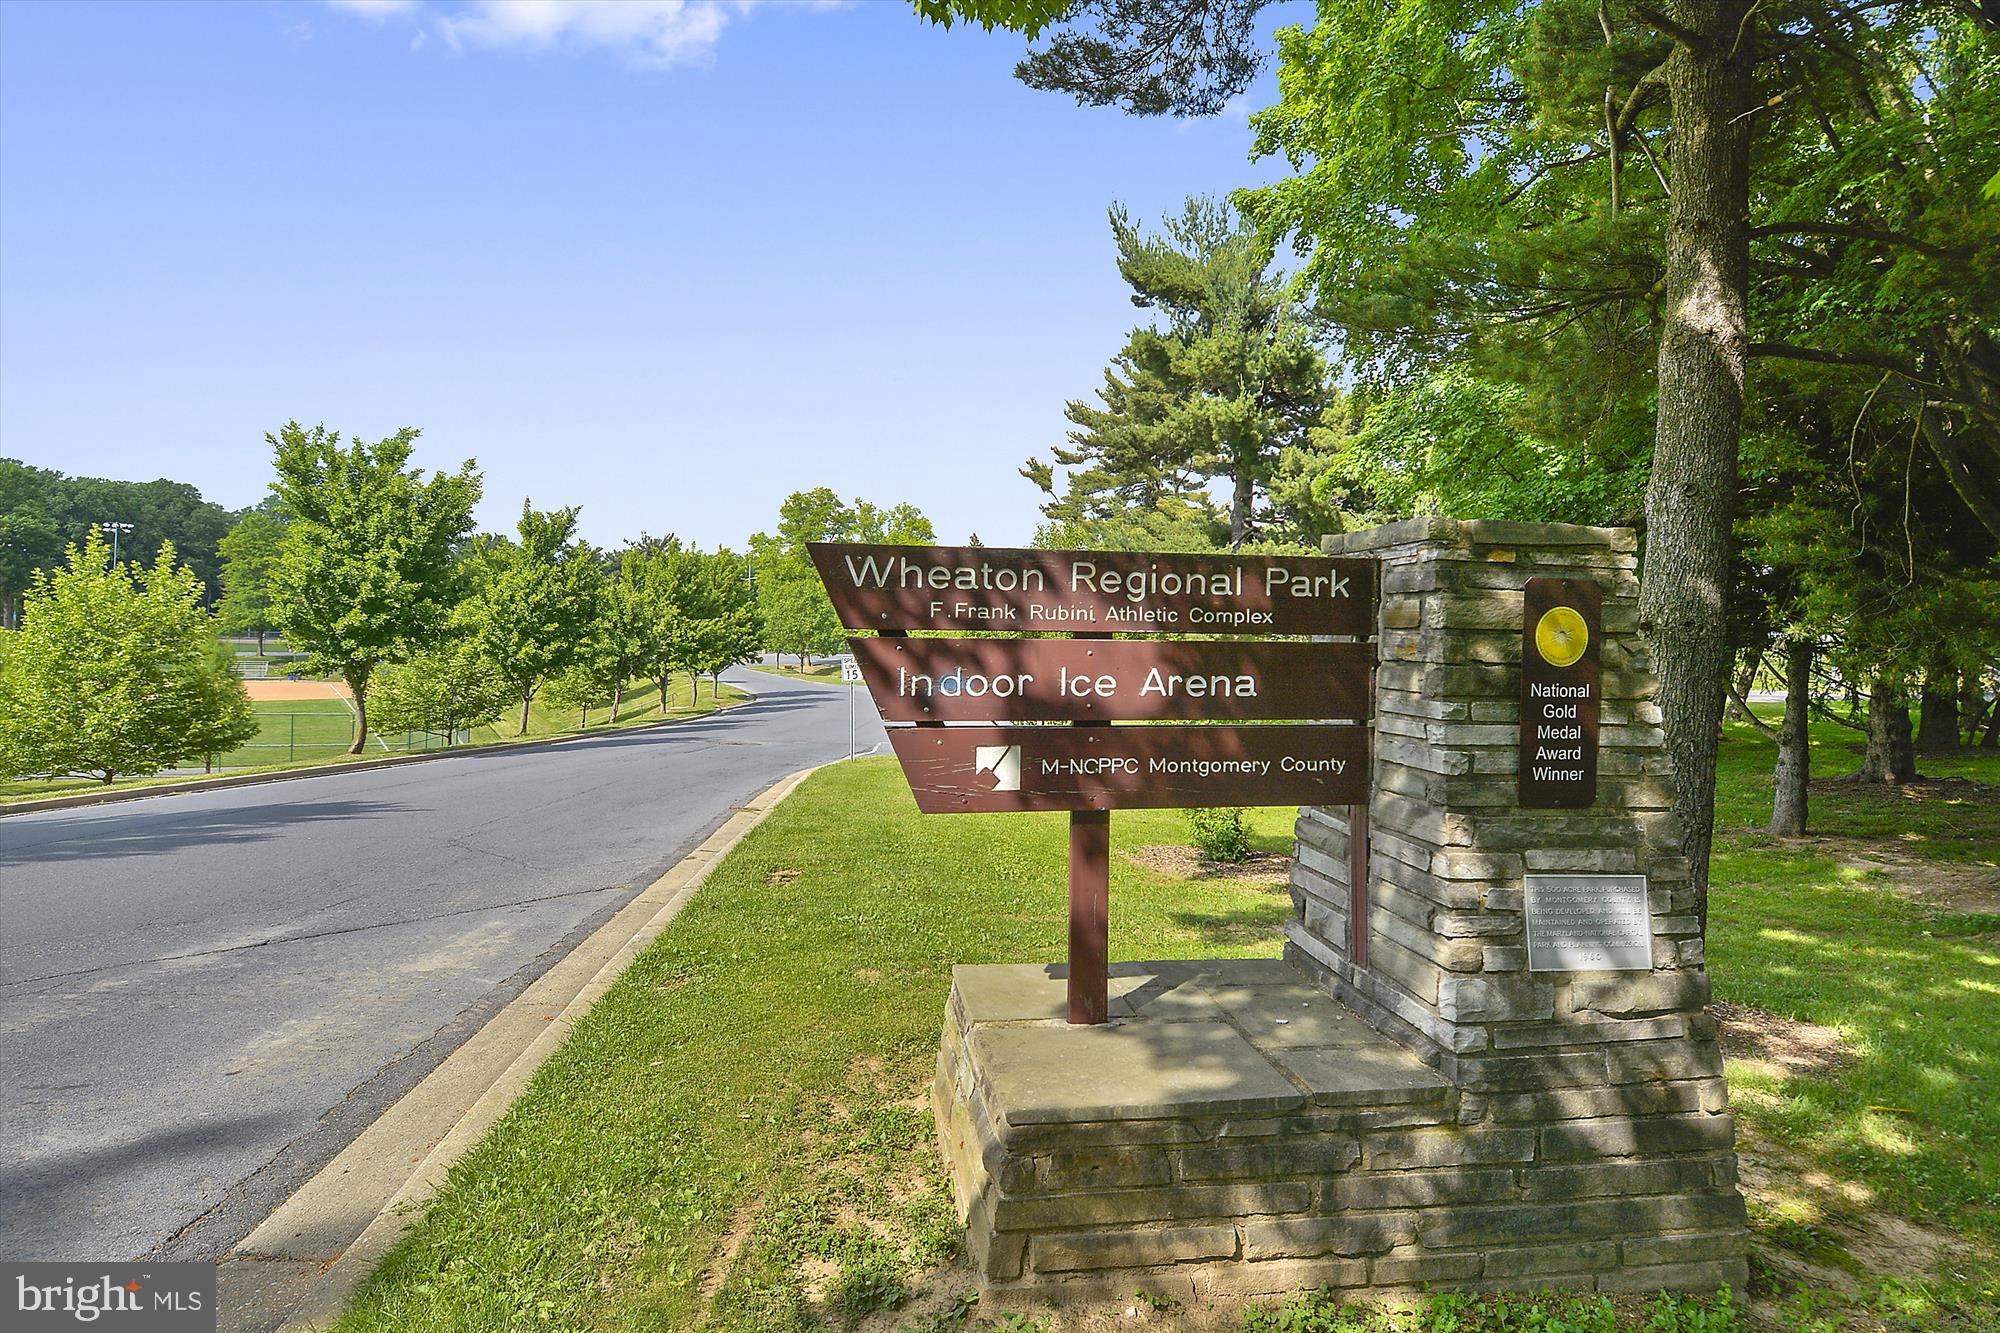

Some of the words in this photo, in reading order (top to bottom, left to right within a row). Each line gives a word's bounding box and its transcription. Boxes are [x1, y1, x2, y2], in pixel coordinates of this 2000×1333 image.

[845, 554, 1044, 592] Wheaton
[1071, 561, 1243, 602] Regional
[1265, 567, 1350, 598] Park
[1029, 604, 1095, 621] Rubini
[1105, 605, 1179, 623] Athletic
[1189, 607, 1274, 627] Complex
[846, 670, 858, 680] 15
[899, 666, 1036, 697] Indoor
[1060, 666, 1117, 697] Ice
[1139, 667, 1257, 697] Arena
[1530, 683, 1590, 698] National
[1543, 704, 1577, 719] Gold
[1537, 725, 1581, 740] Medal
[1535, 746, 1582, 760] Award
[1041, 758, 1139, 775] M-NCPPC
[1149, 757, 1271, 777] Montgomery
[1280, 756, 1346, 774] County
[1532, 767, 1585, 781] Winner
[1530, 896, 1541, 904] BY
[1545, 896, 1598, 904] MONTGOMERY
[1531, 907, 1553, 915] BEING
[1555, 907, 1595, 915] DEVELOPED
[1598, 907, 1613, 915] AND
[1533, 941, 1550, 949] PARK
